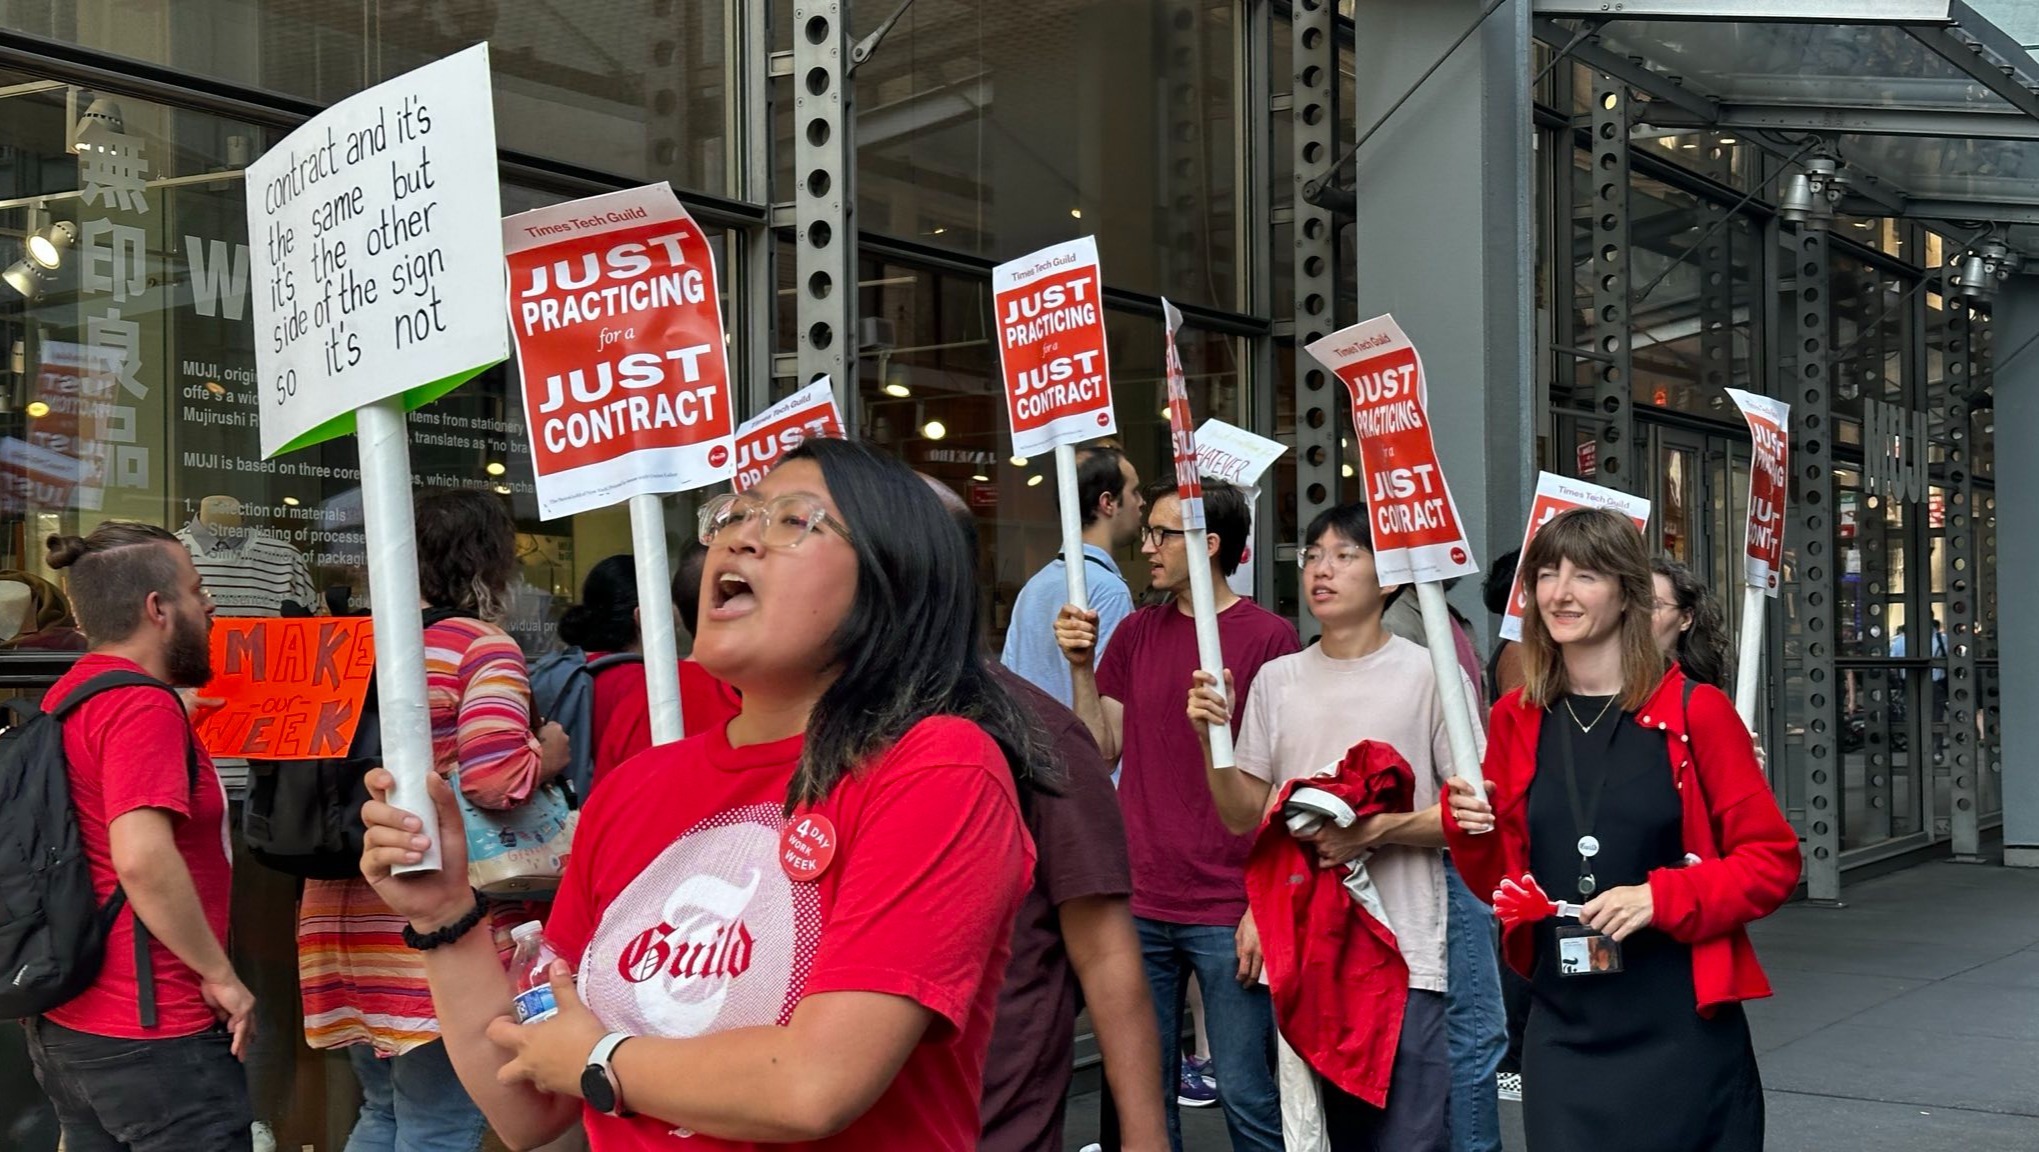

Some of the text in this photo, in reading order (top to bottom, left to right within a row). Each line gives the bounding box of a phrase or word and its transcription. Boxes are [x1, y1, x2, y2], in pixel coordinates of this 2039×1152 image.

[265, 94, 432, 215] contract and it's
[268, 145, 435, 267] the same but
[525, 206, 648, 239] Times Tech Guild
[270, 201, 438, 313] it's the other
[521, 231, 691, 298] JUST
[1011, 253, 1077, 282] Times Tech Guild
[273, 248, 445, 354] side of the sign
[521, 269, 706, 337] PRACTICING
[1004, 276, 1092, 325] JUST
[276, 285, 447, 407] so it's not
[597, 328, 636, 353] for a
[1006, 302, 1096, 350] PRACTICING
[183, 360, 222, 380] MUJI,
[540, 343, 712, 414] JUST
[1014, 349, 1099, 397] JUST
[1353, 363, 1416, 406] JUST
[183, 385, 223, 402] offes
[226, 392, 235, 403] a
[442, 412, 469, 428] from
[543, 385, 718, 454] CONTRACT
[1016, 375, 1103, 420] CONTRACT
[1355, 399, 1424, 440] PRACTICING
[183, 406, 247, 428] Mujirushi
[414, 431, 470, 448] translates
[472, 437, 486, 450] as
[737, 416, 830, 470] JUST
[184, 452, 218, 468] MUJI
[221, 455, 233, 470] is
[236, 457, 276, 474] based
[279, 462, 296, 476] on
[299, 463, 331, 478] three
[333, 467, 361, 481] core
[427, 473, 460, 488] which
[462, 477, 499, 491] remain
[1196, 443, 1251, 483] HATEVER
[1373, 463, 1434, 502] JUST
[184, 498, 195, 513] 1.
[273, 505, 287, 518] of
[290, 506, 347, 522] materials
[1558, 485, 1585, 499] Times
[1585, 492, 1606, 504] Tech
[295, 527, 309, 542] of
[224, 619, 374, 692] MAKE
[205, 698, 353, 757] WEEK
[788, 833, 813, 857] WORK
[796, 818, 831, 849] 4 DAY
[784, 849, 817, 871] WEEK
[617, 918, 756, 983] Guild
